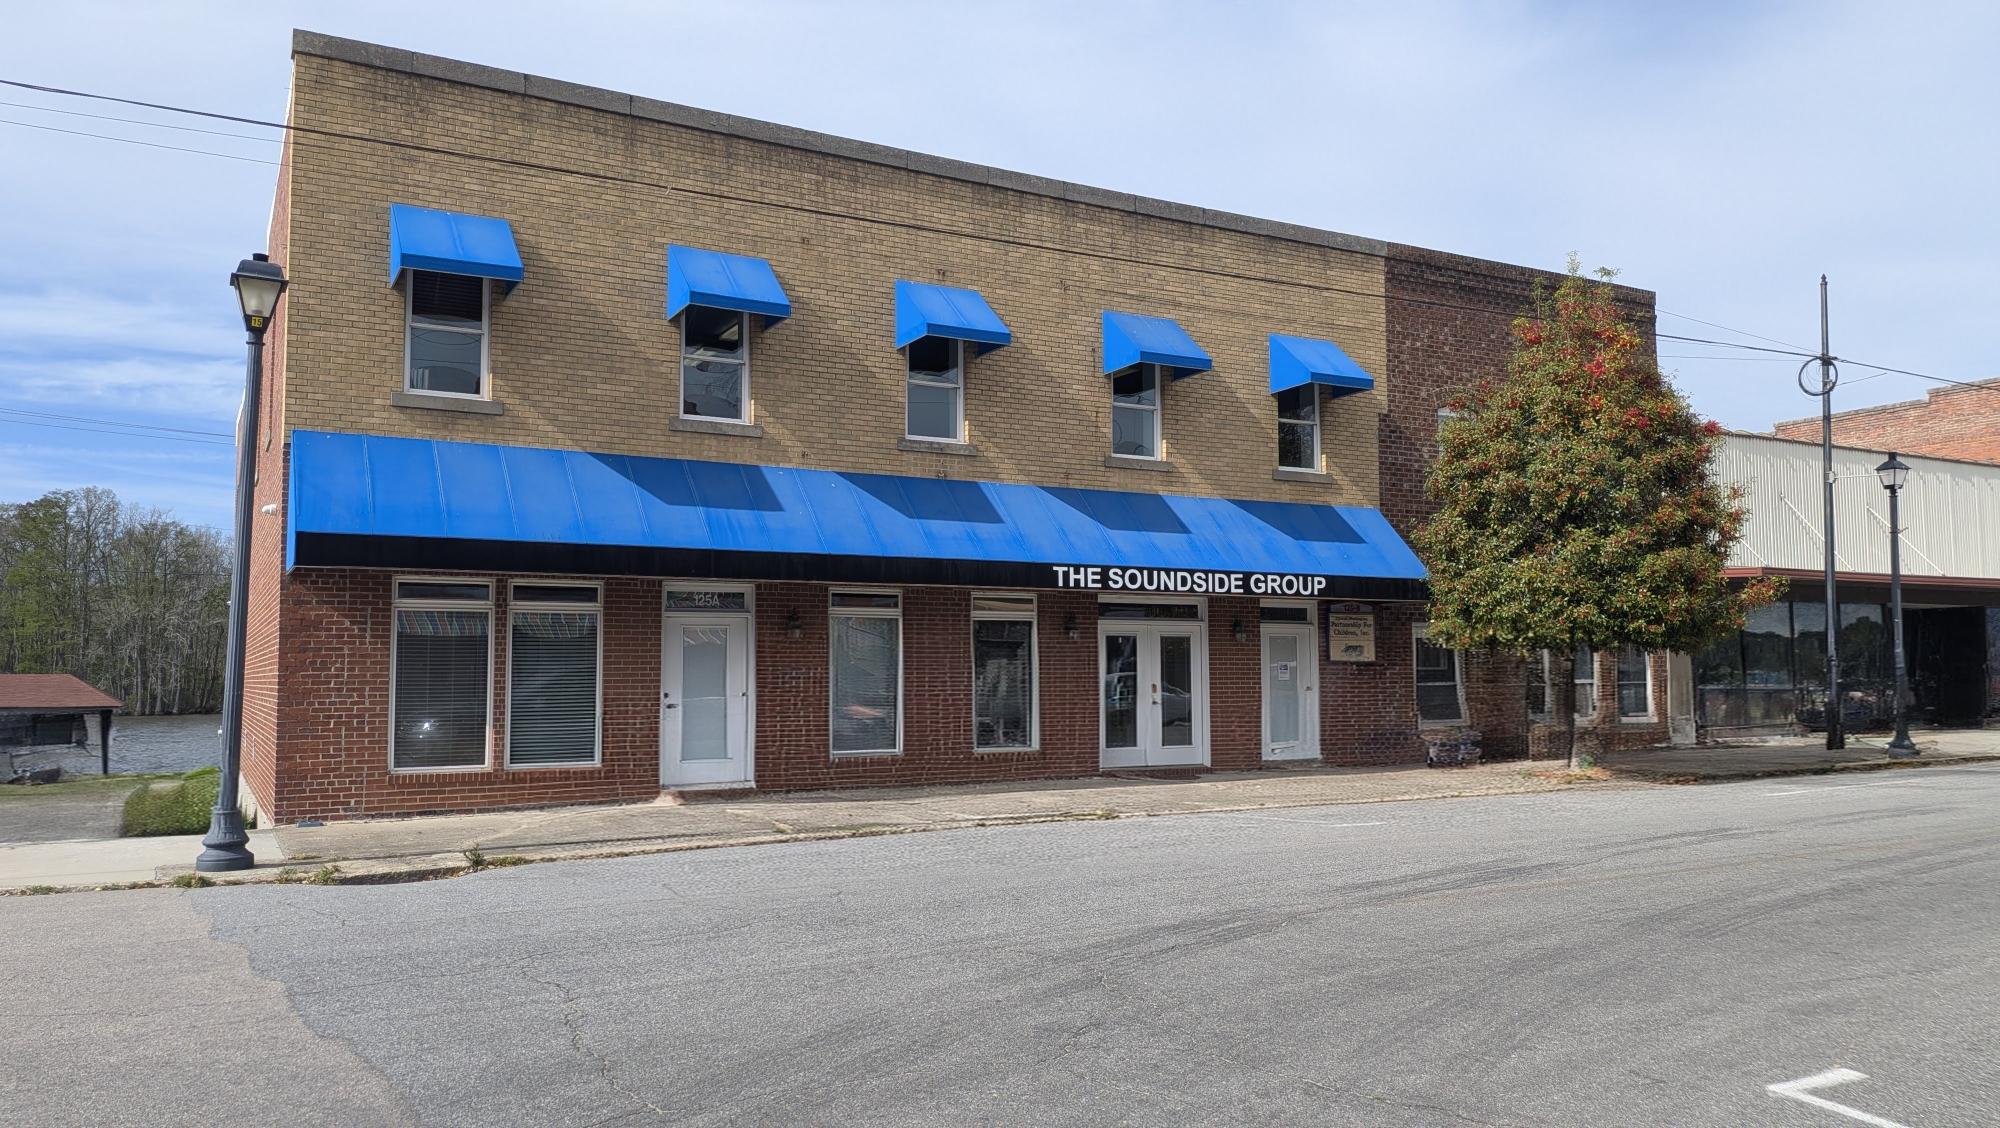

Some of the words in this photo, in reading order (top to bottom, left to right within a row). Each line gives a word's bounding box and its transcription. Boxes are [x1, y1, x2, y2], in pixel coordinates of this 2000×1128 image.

[252, 318, 262, 326] 15
[1052, 566, 1102, 588] THE
[1108, 568, 1244, 593] SOUNDSIDE
[1250, 573, 1327, 596] GROUP
[694, 594, 720, 606] 125A
